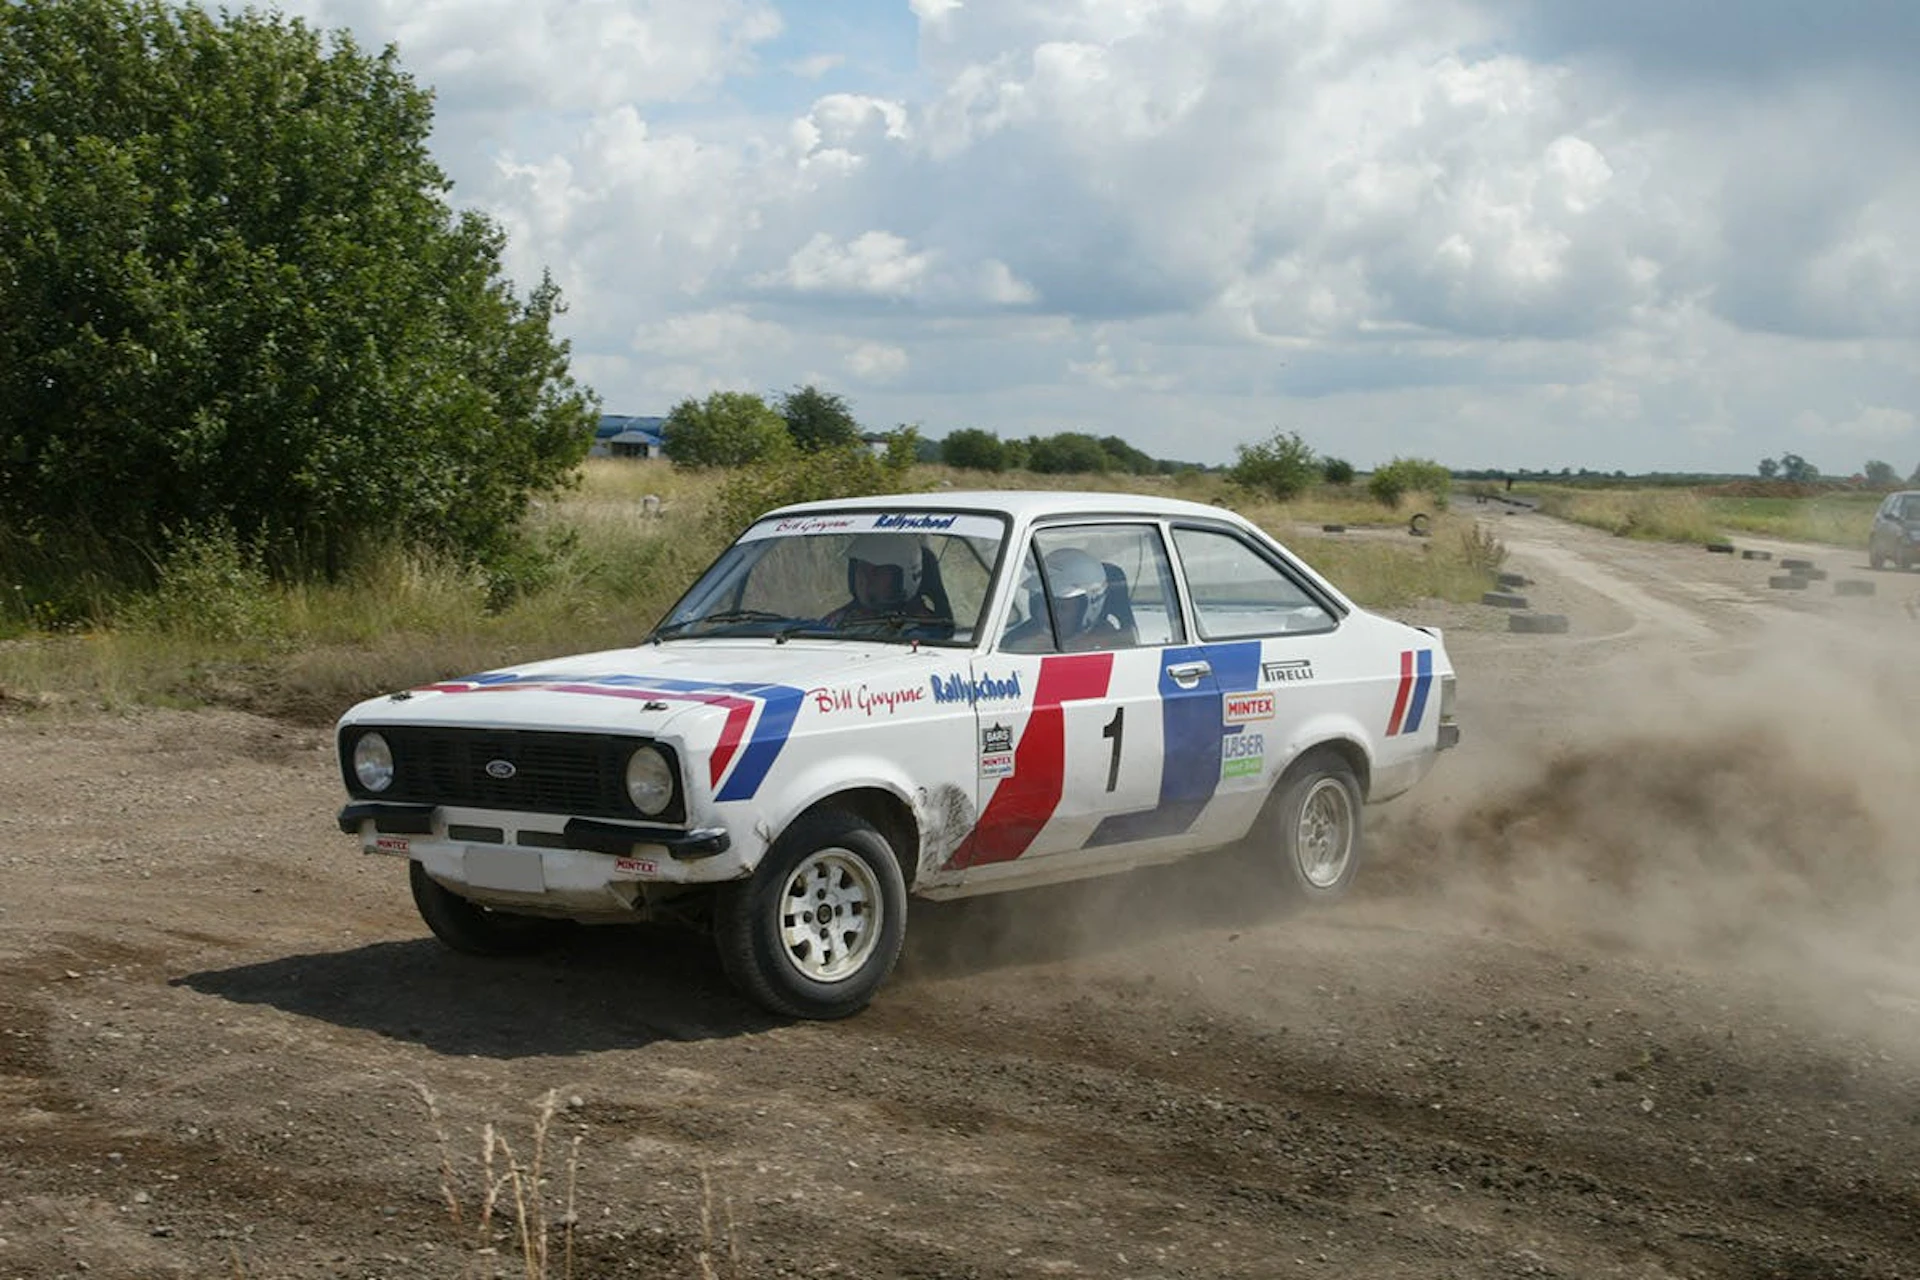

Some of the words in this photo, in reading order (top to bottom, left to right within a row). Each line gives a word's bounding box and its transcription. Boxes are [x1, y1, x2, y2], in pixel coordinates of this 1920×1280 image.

[873, 513, 957, 530] Rallyschool
[1262, 660, 1314, 682] PIRELLI
[806, 687, 851, 713] Bill
[857, 685, 924, 716] Gwynne
[930, 670, 1021, 706] Rallyschool
[1228, 699, 1273, 715] MINTEX
[1103, 707, 1123, 792] 1
[1224, 735, 1263, 758] LASER
[617, 860, 654, 872] MINTEX
